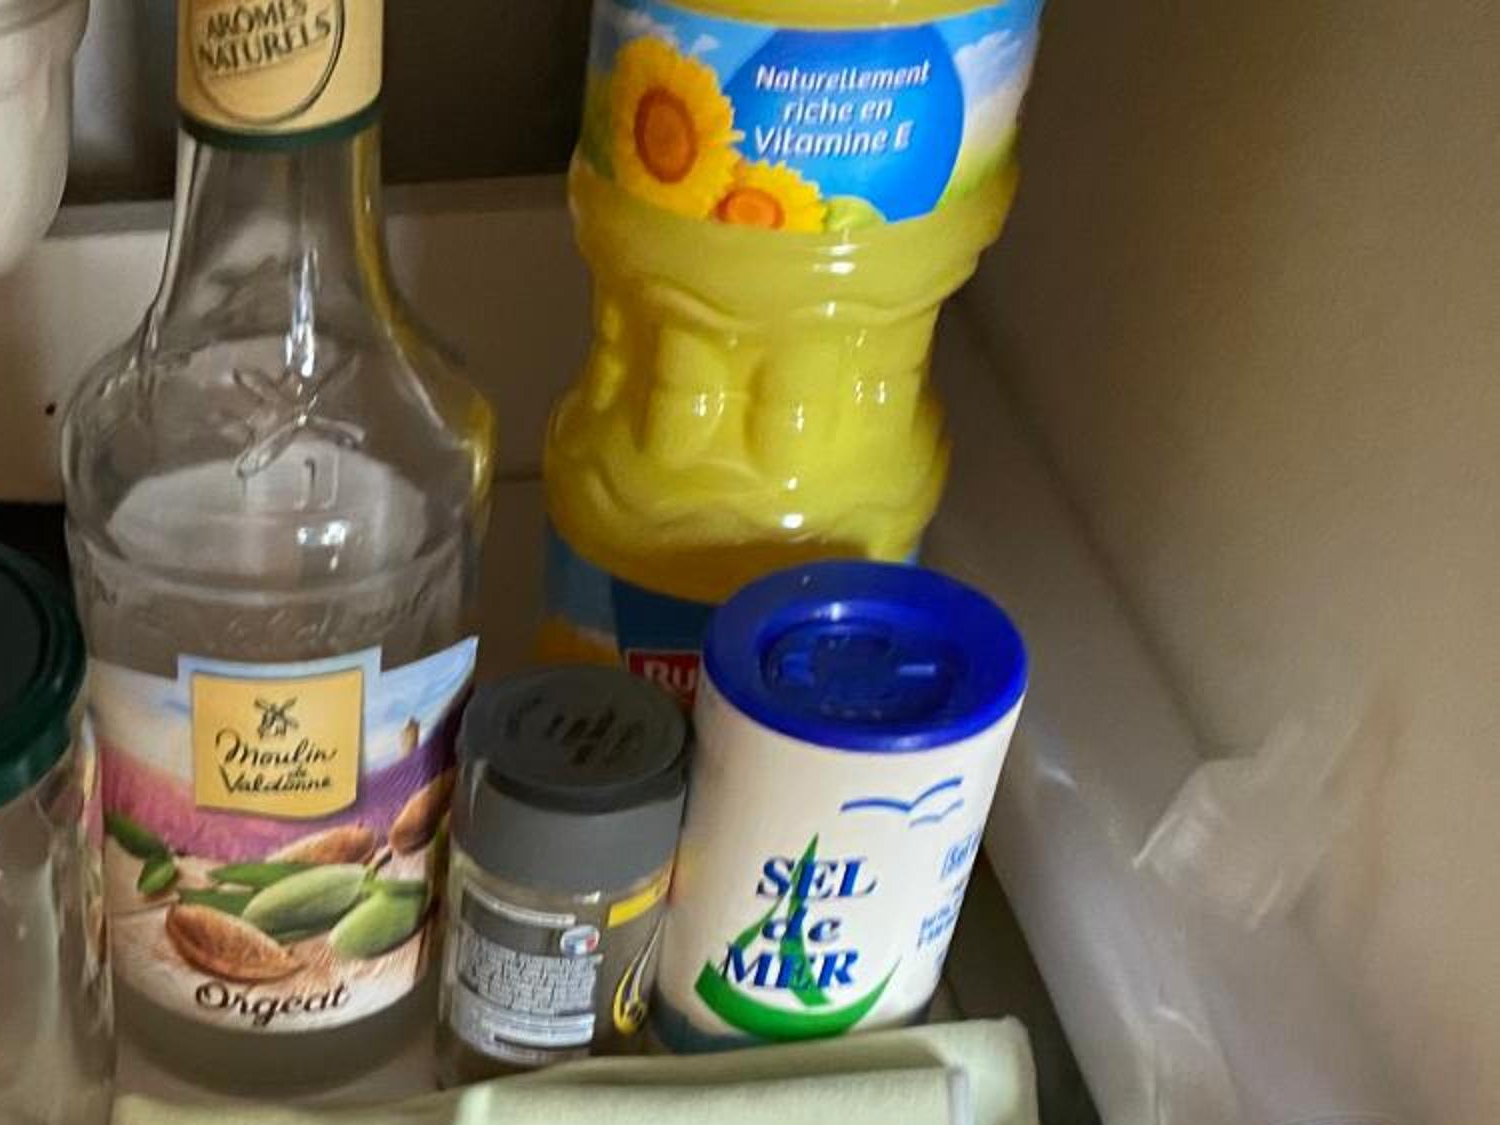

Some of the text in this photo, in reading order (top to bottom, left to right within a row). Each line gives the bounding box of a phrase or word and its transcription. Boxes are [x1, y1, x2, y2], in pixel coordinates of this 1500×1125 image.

[198, 6, 332, 70] NATURELS
[206, 0, 308, 40] AROMES
[754, 59, 931, 93] Naturellement
[782, 96, 893, 124] riche en
[754, 120, 915, 157] Vitamine E
[643, 660, 695, 692] RU
[214, 727, 338, 767] Moulin
[755, 855, 878, 900] SEL
[761, 904, 842, 943] de
[722, 942, 860, 992] MER
[194, 979, 349, 1027] Orgeat
